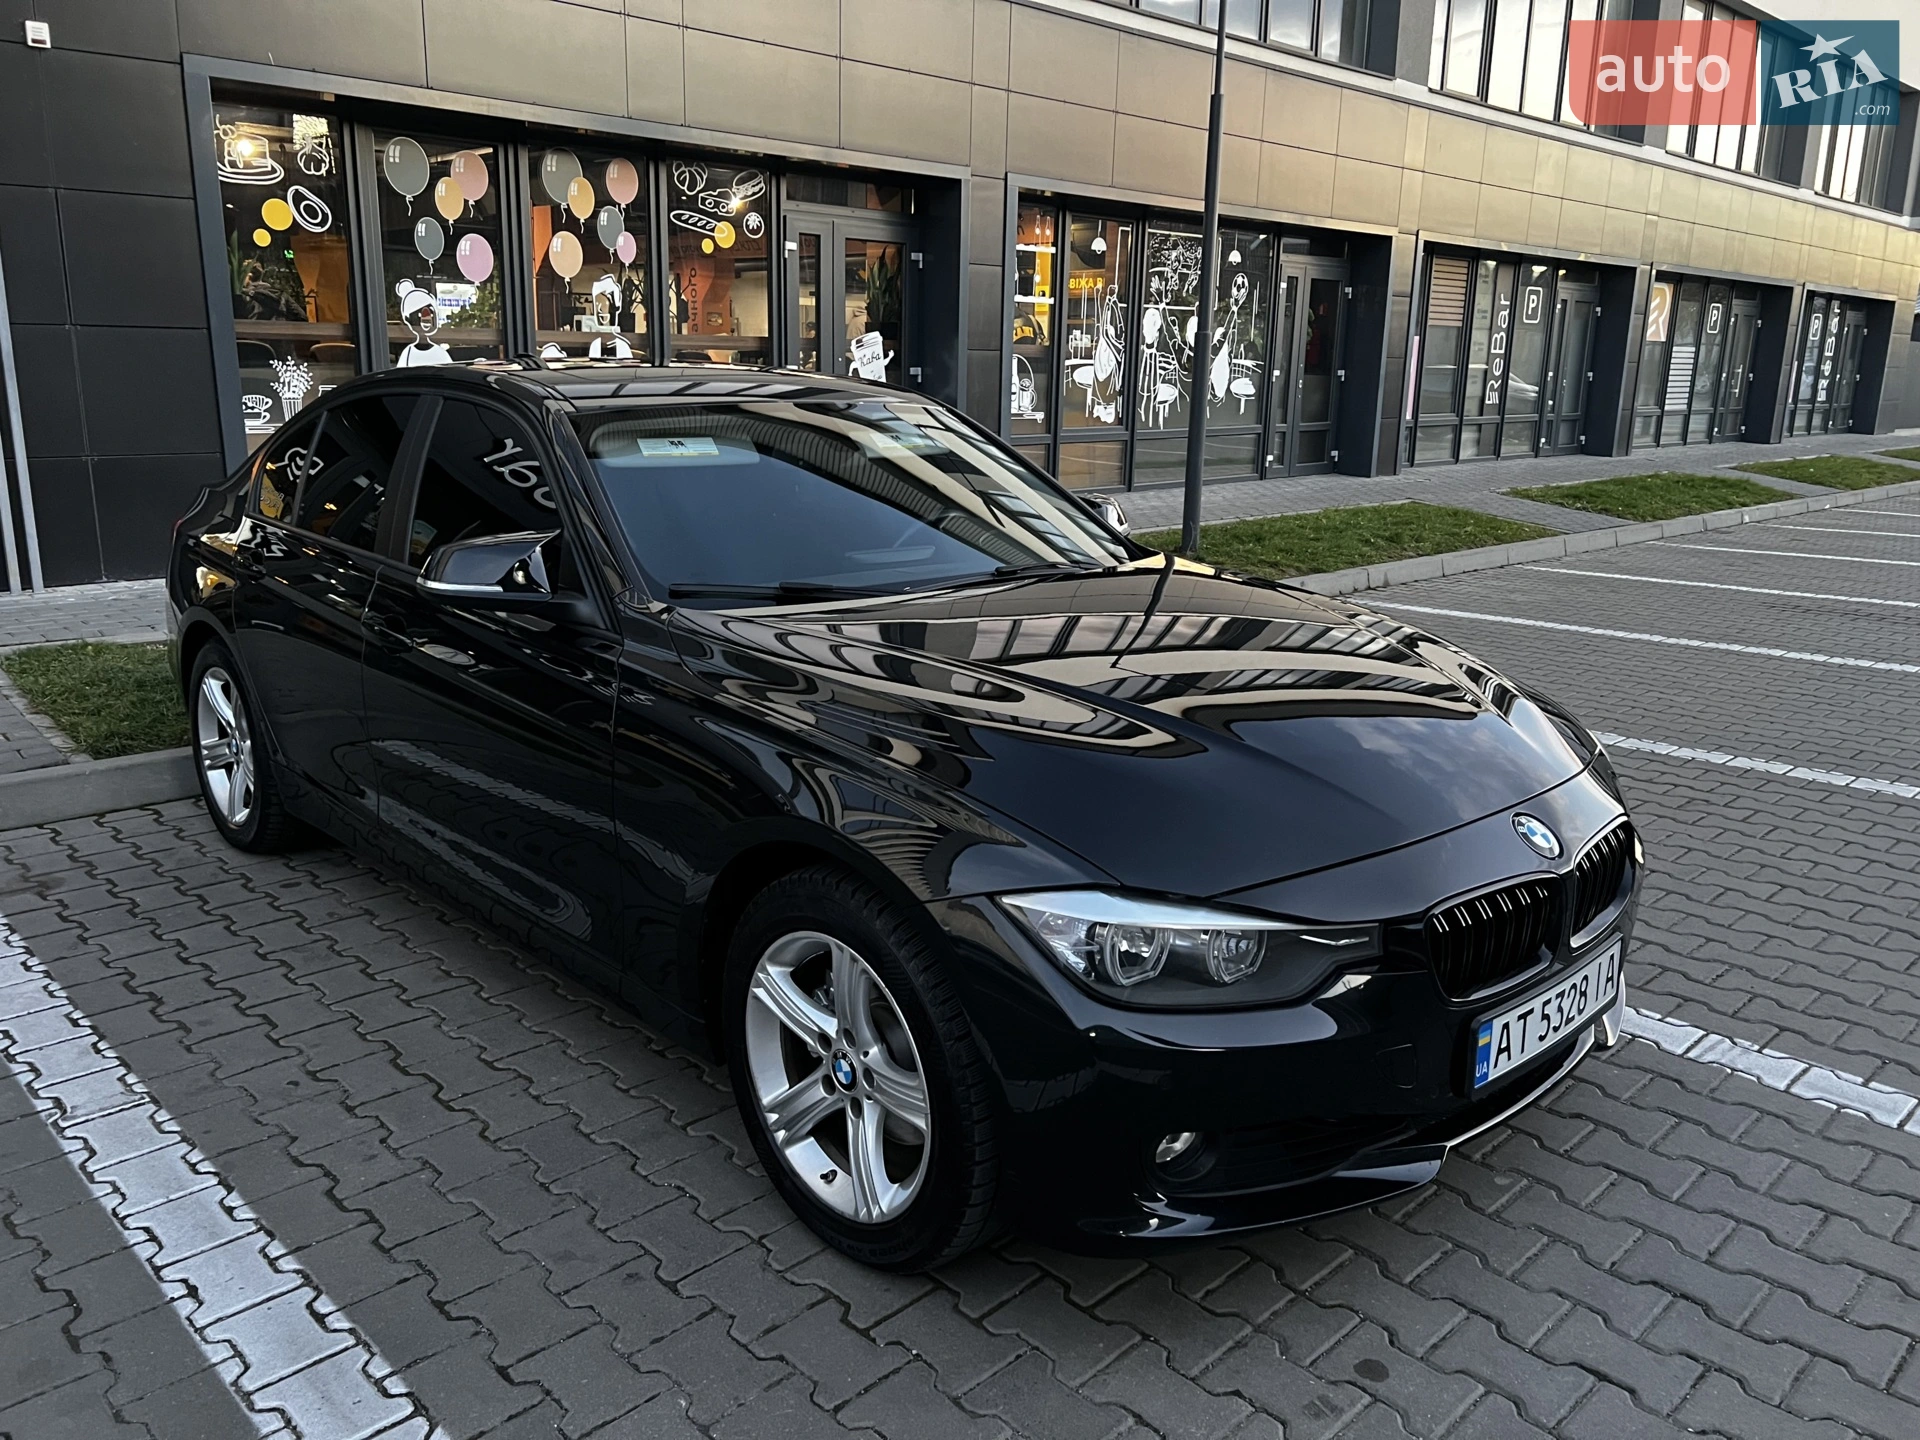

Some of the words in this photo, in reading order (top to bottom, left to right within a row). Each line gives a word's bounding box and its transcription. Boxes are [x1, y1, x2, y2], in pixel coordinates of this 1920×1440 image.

[1485, 293, 1511, 404] ReBar
[1816, 303, 1840, 401] ReBar
[1493, 1007, 1534, 1069] AT
[1538, 974, 1589, 1042] 5328
[1595, 951, 1615, 1002] IA
[1476, 1064, 1488, 1077] UA
